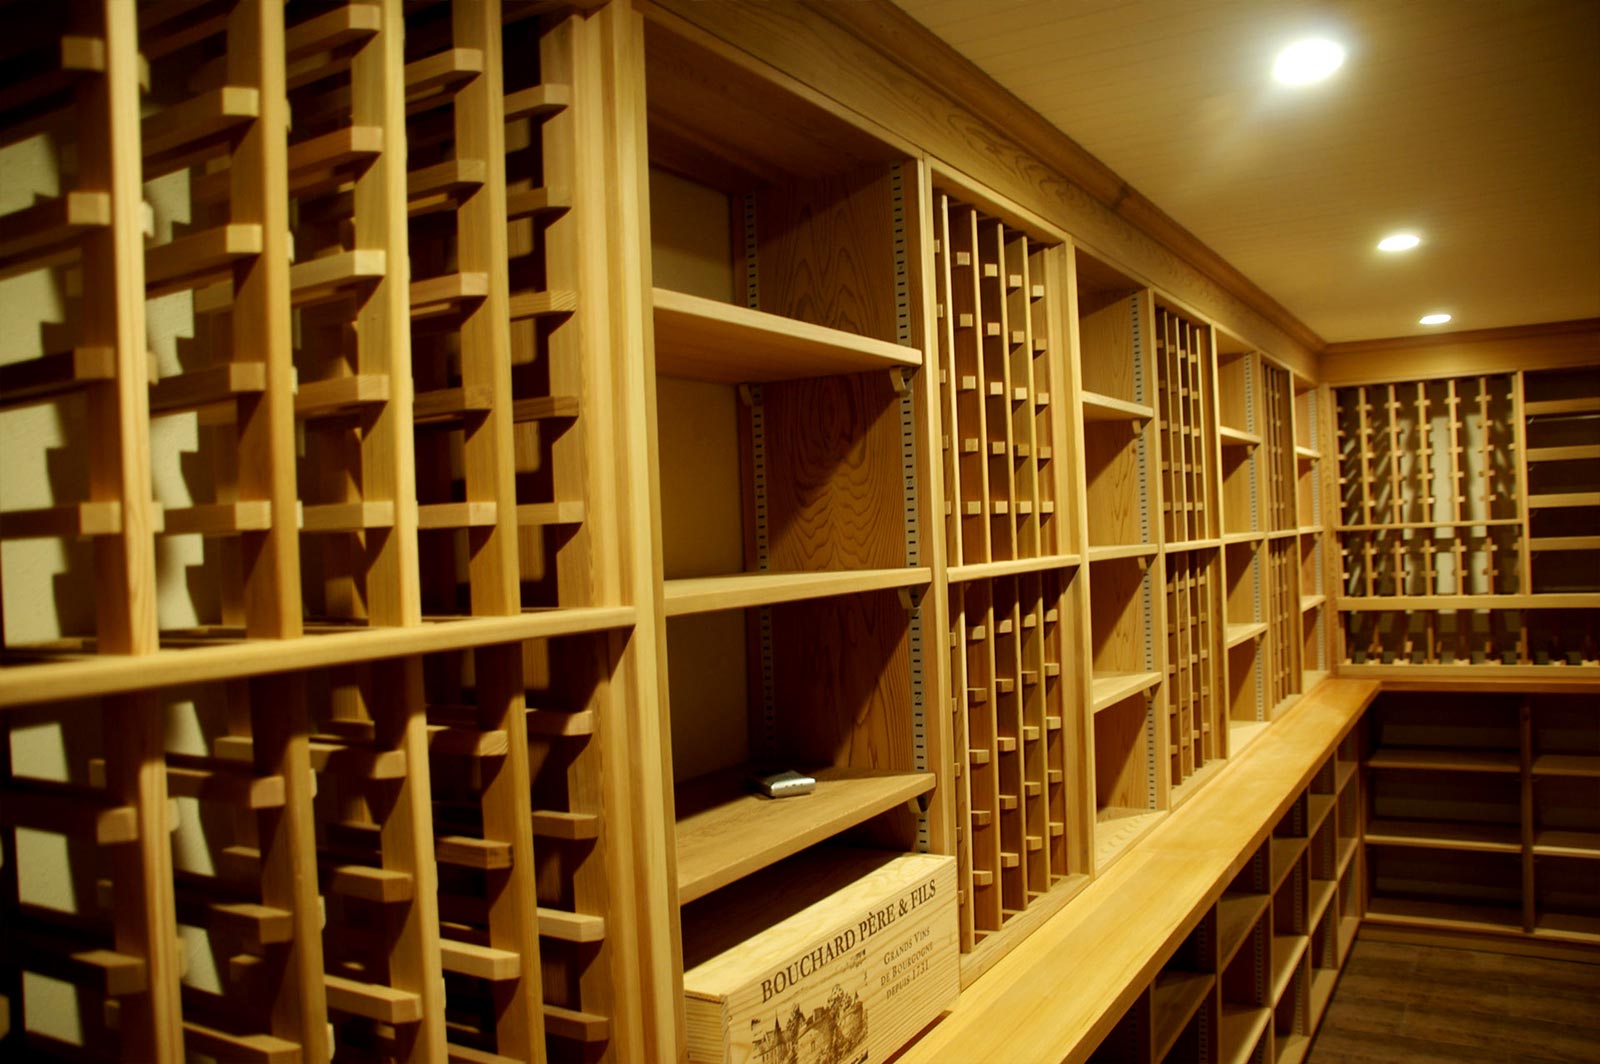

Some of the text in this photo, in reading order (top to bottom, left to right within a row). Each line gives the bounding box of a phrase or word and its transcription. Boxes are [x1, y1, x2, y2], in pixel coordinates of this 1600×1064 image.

[760, 879, 936, 1003] BOUCHARD PÈRE & FILS
[883, 926, 930, 965] GRANDS VINS
[880, 972, 890, 986] DE
[886, 959, 929, 1000] DEPUIS 1731
